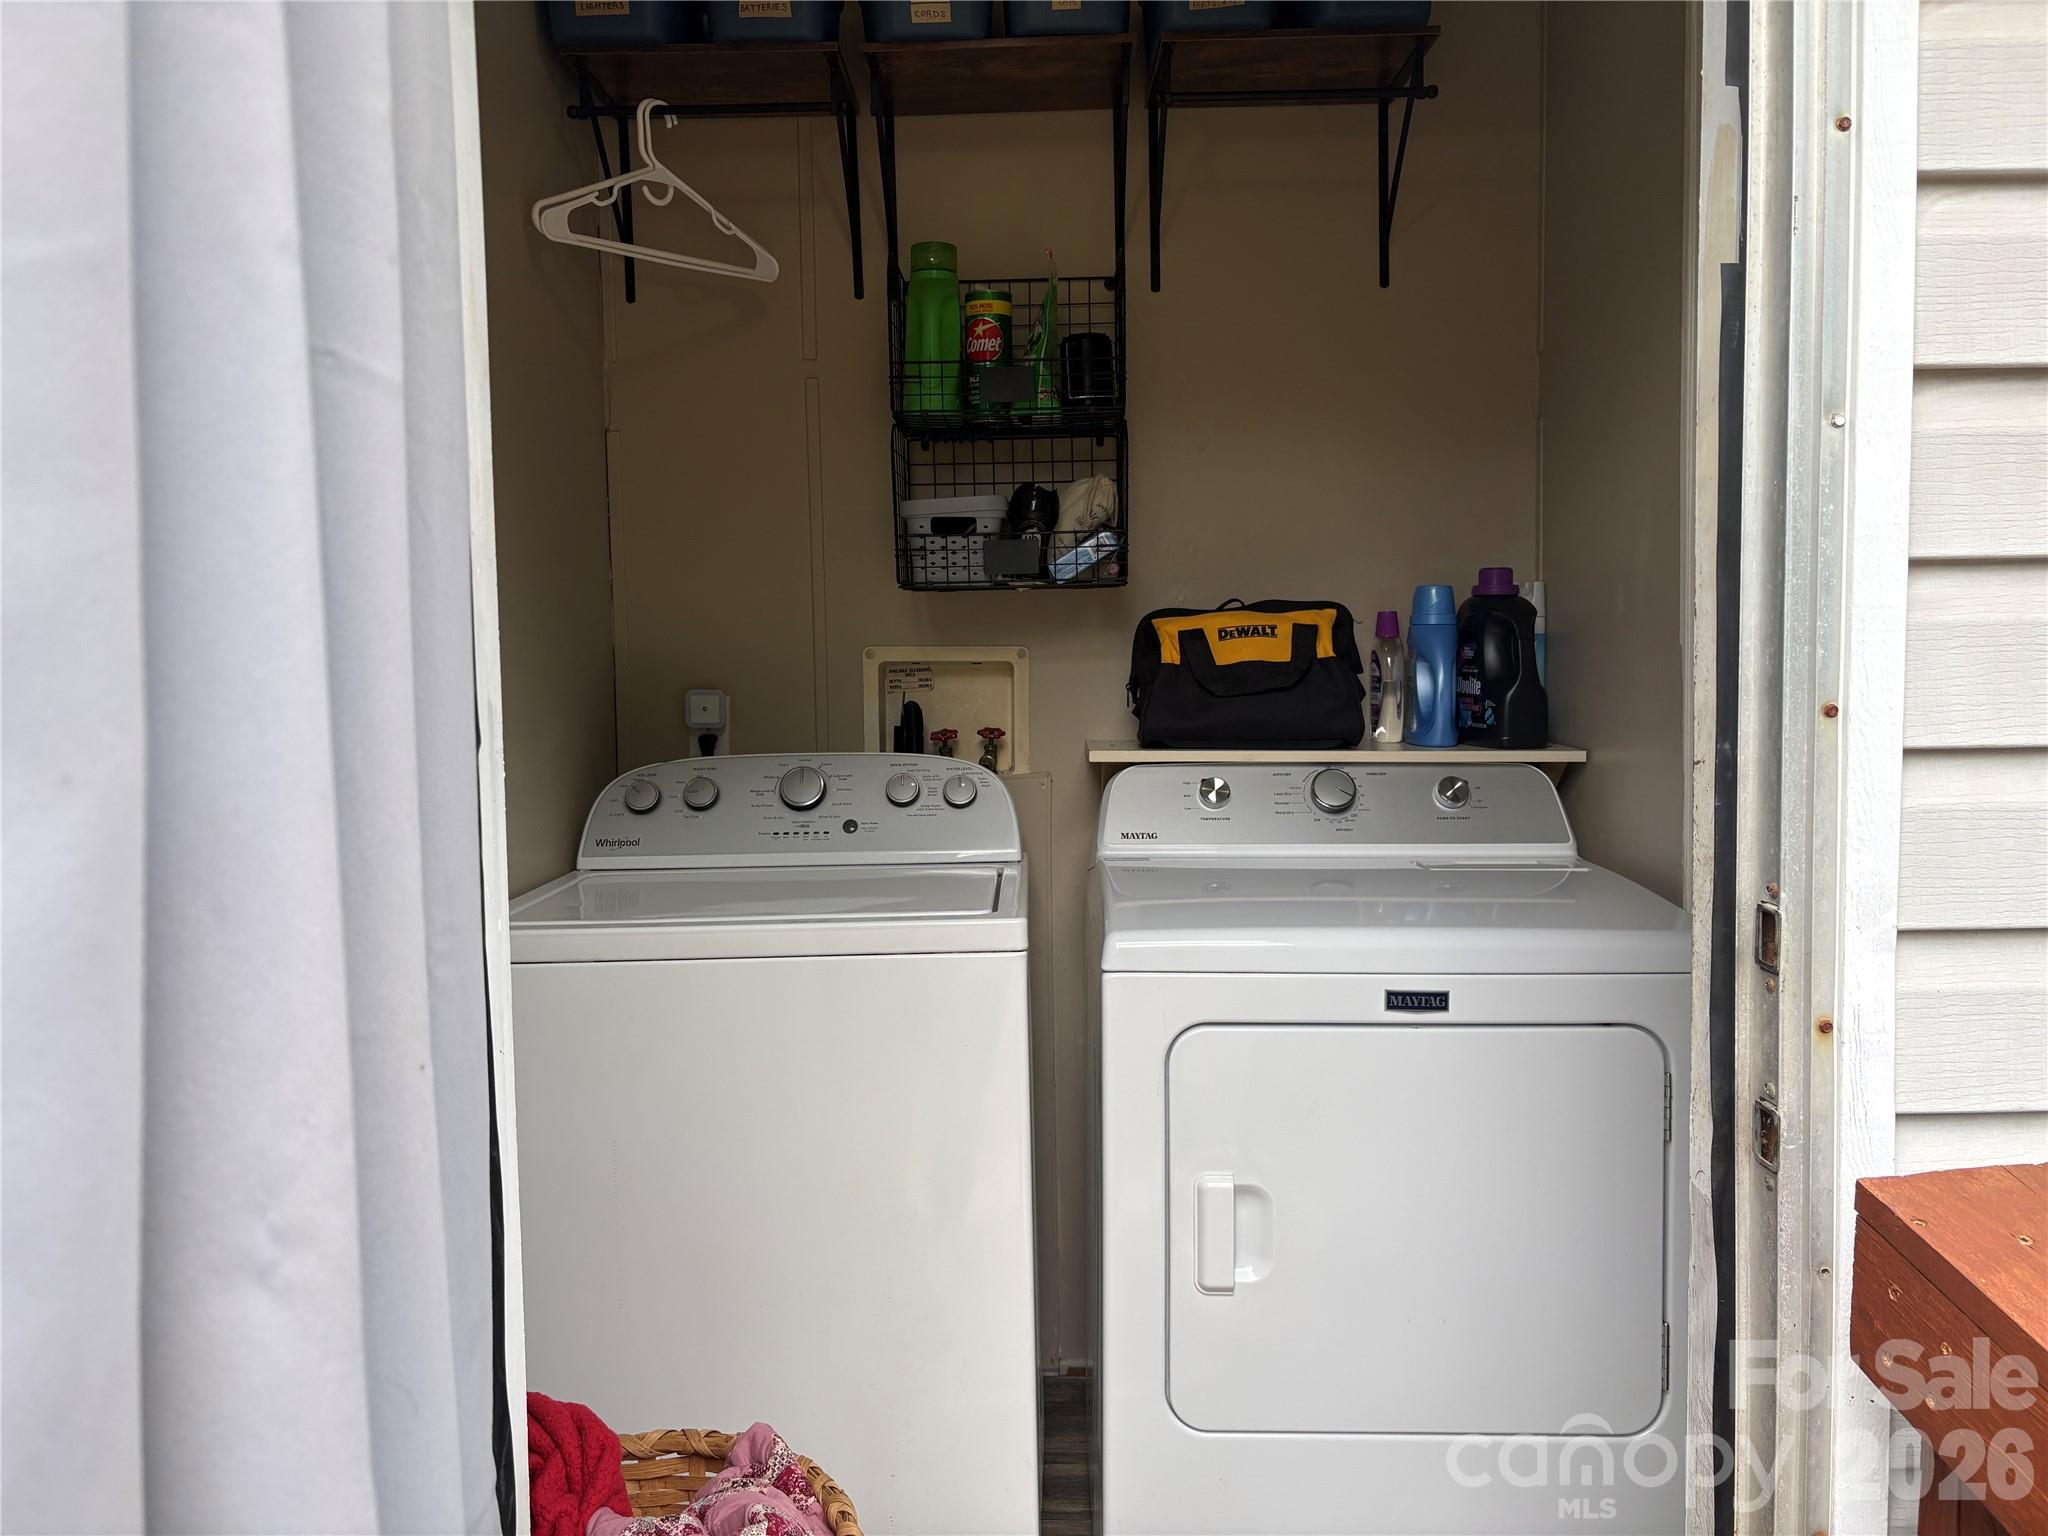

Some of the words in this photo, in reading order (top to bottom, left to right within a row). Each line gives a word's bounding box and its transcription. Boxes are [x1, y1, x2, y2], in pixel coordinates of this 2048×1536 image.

[740, 3, 788, 13] BATTERIES
[914, 10, 946, 18] CORDS
[967, 337, 1002, 354] Comet
[1218, 625, 1278, 641] DEWALT
[1120, 832, 1158, 840] MAYTAG
[595, 837, 641, 849] Whirlpool
[1389, 995, 1447, 1007] MAYTAG
